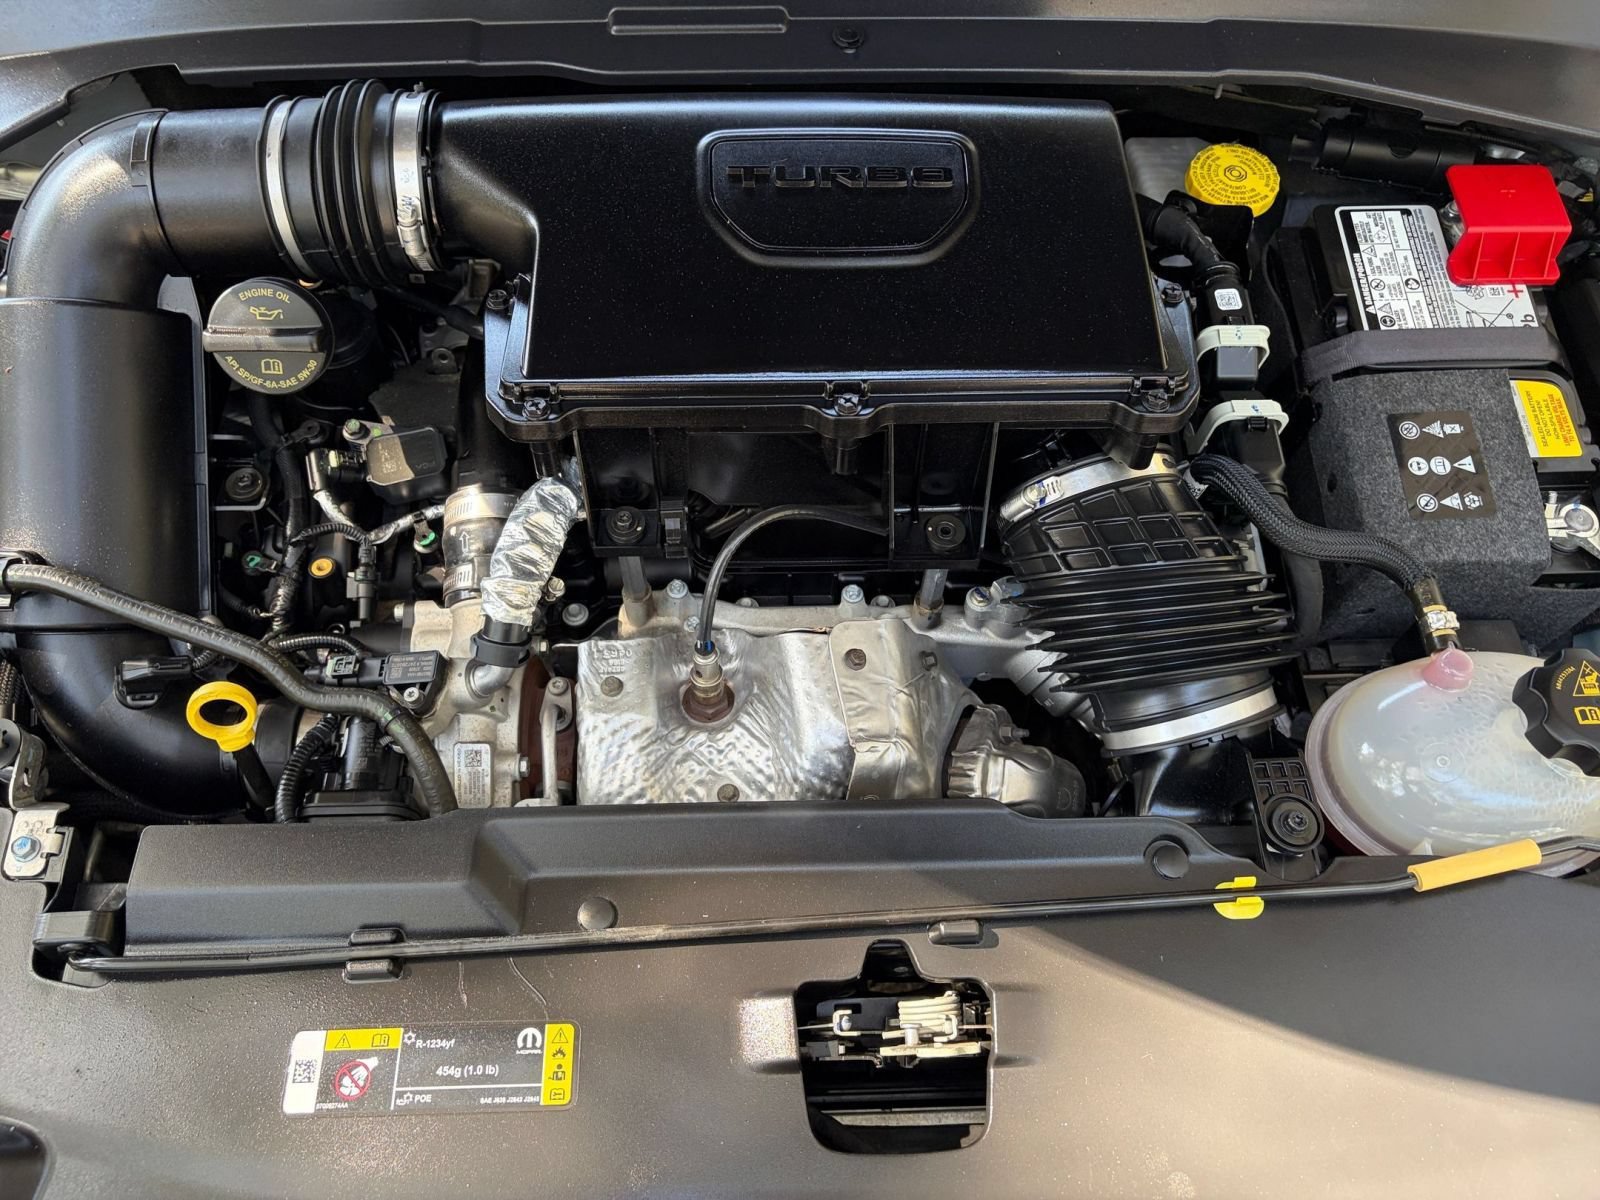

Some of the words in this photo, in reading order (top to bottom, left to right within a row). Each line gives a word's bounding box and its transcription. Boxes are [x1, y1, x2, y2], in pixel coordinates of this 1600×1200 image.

[727, 165, 954, 188] TURBO
[1353, 253, 1374, 305] DANGER/POISON
[238, 288, 274, 301] ENGINE
[275, 291, 291, 304] OIL
[225, 355, 240, 370] API
[237, 367, 299, 389] SP/GF-6A-SAE
[298, 359, 317, 381] 5W-30
[1525, 391, 1537, 413] BATTERY
[1541, 417, 1549, 427] NOT
[1537, 426, 1549, 447] SEALED
[1545, 429, 1552, 437] DO
[415, 1038, 456, 1050] R-1234yf
[436, 1065, 462, 1078] 454g
[464, 1064, 483, 1078] (1.0
[485, 1064, 499, 1077] lb)
[414, 1094, 432, 1103] POE
